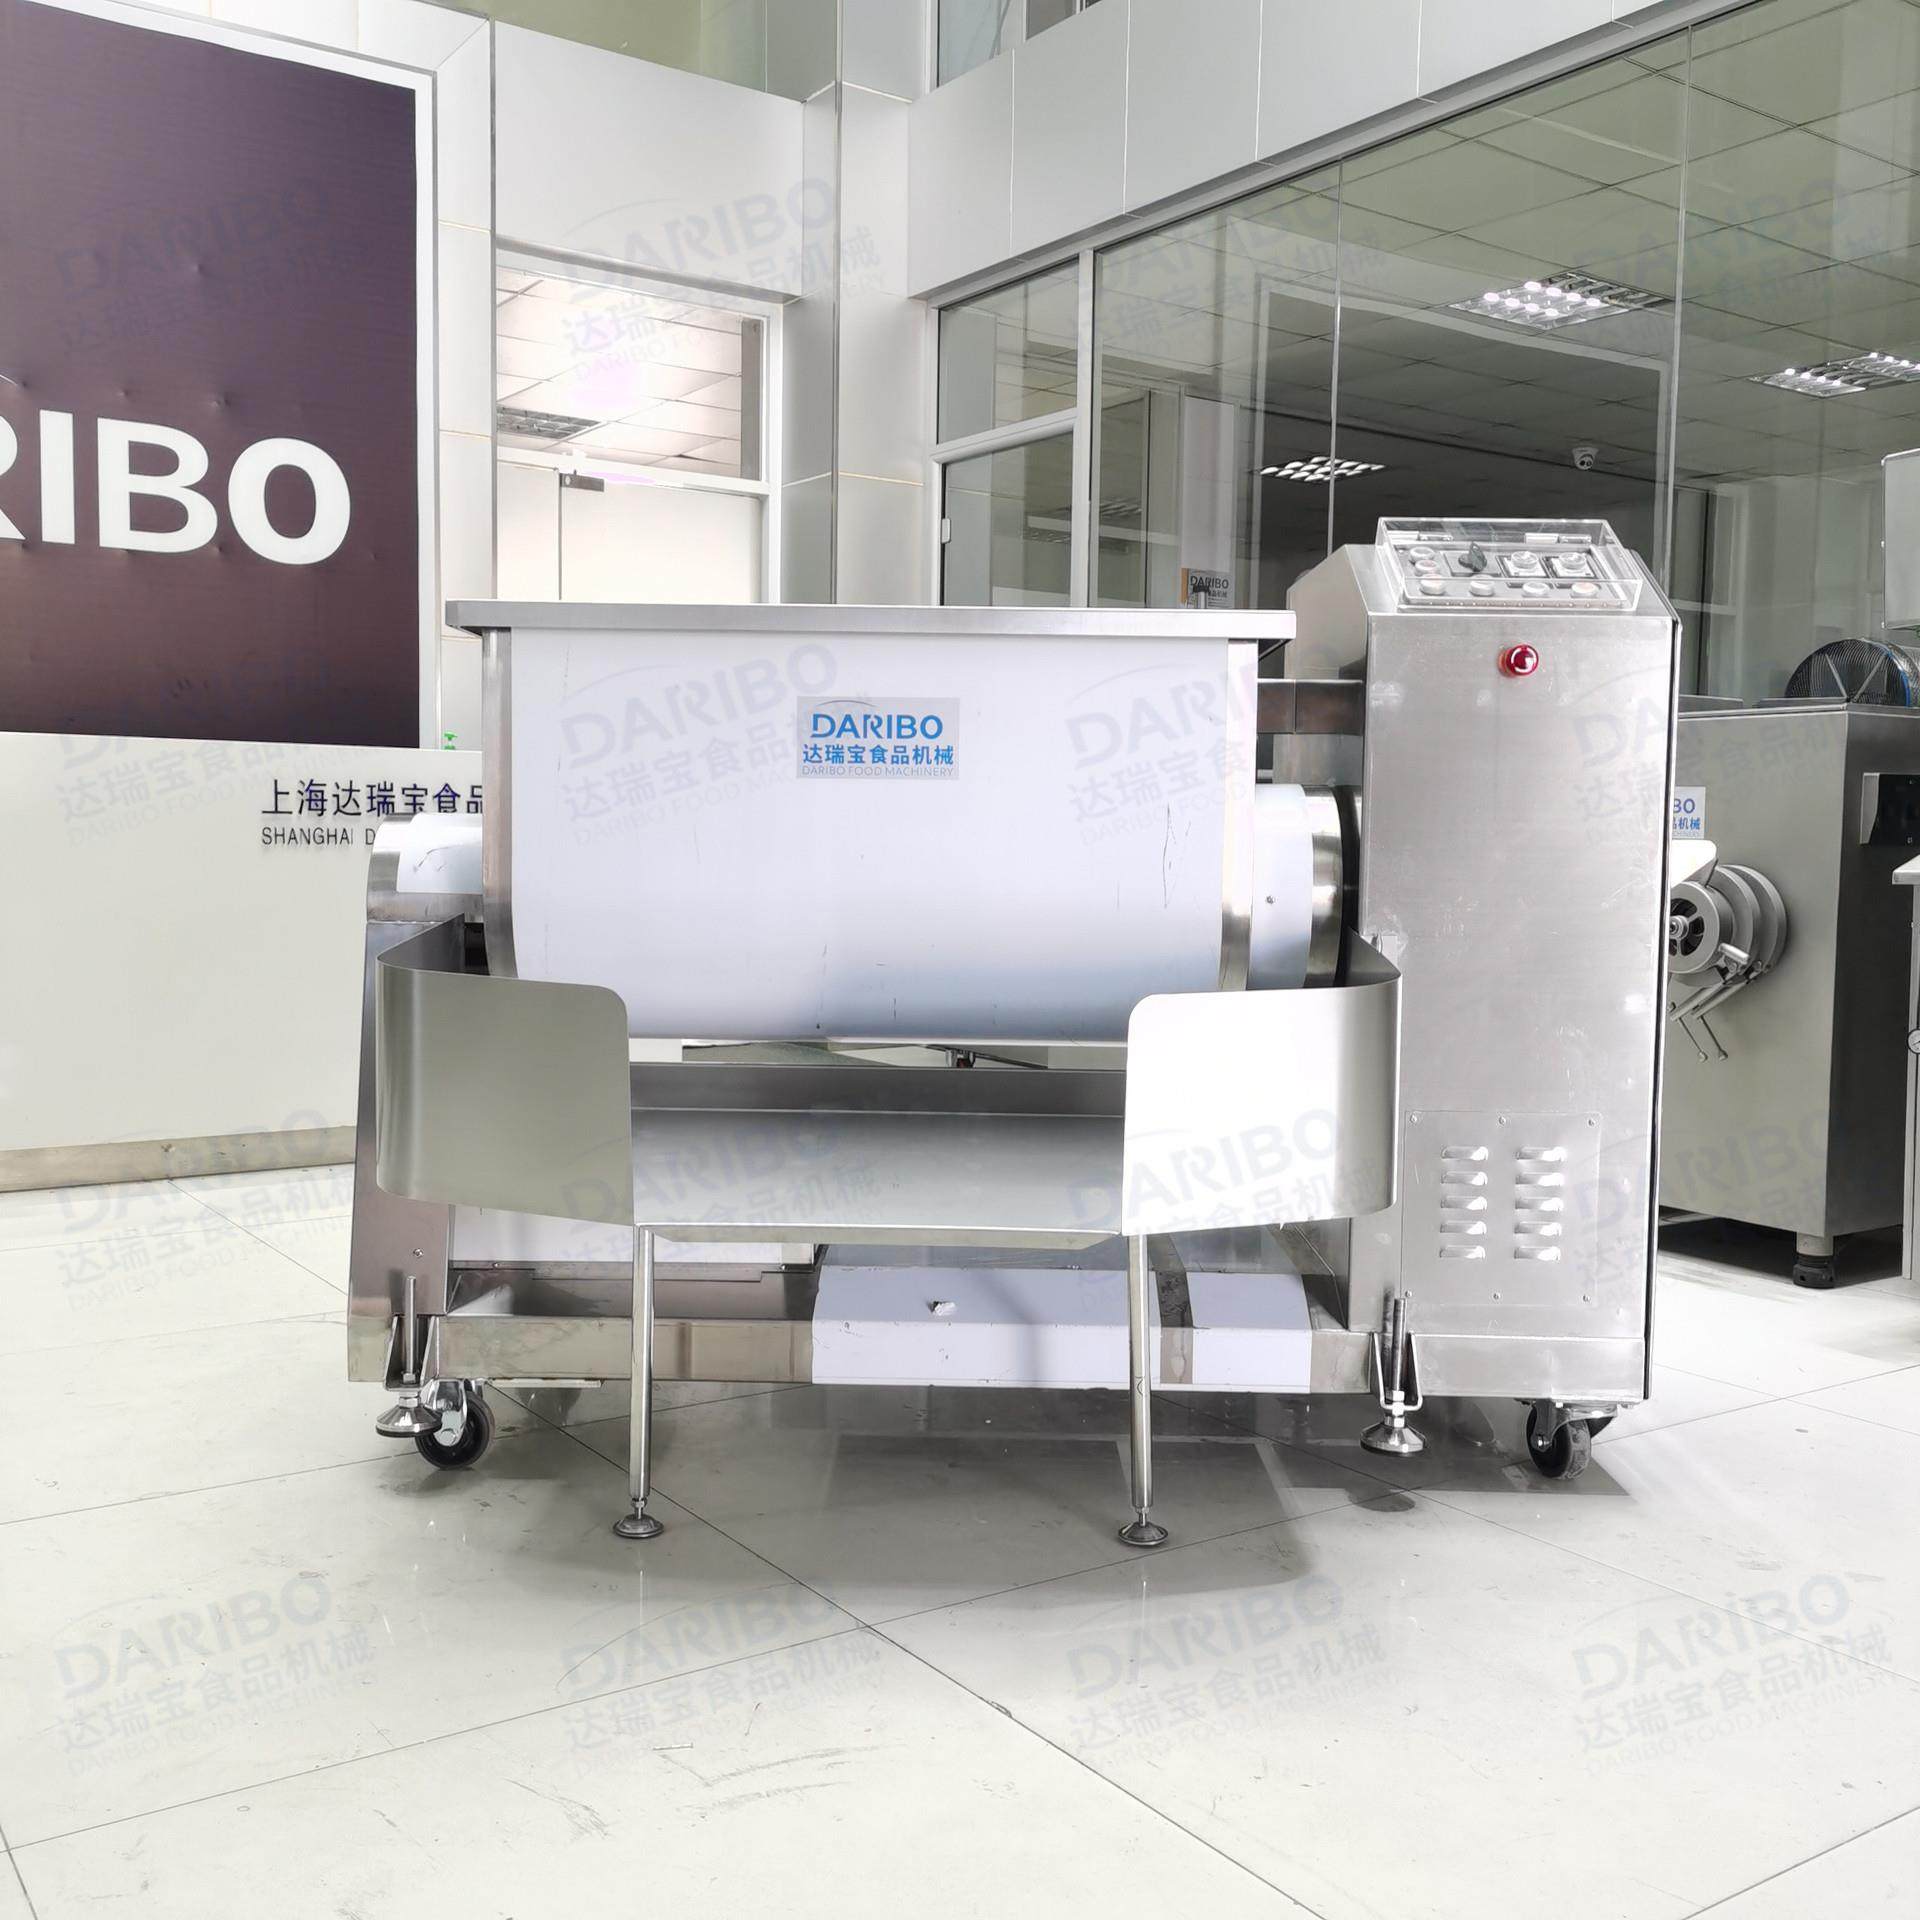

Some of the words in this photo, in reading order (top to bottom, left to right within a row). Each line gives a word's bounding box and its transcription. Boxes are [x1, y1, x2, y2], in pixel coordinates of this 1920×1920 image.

[0, 409, 351, 565] IBO
[1190, 576, 1229, 589] DARIBO
[810, 713, 943, 740] DARIBO
[803, 743, 954, 765] 达瑞宝食品机械
[802, 765, 846, 776] DARIBO
[849, 766, 883, 777] FOOD
[885, 767, 954, 777] MACHINERY
[262, 827, 353, 846] SHANGHAI
